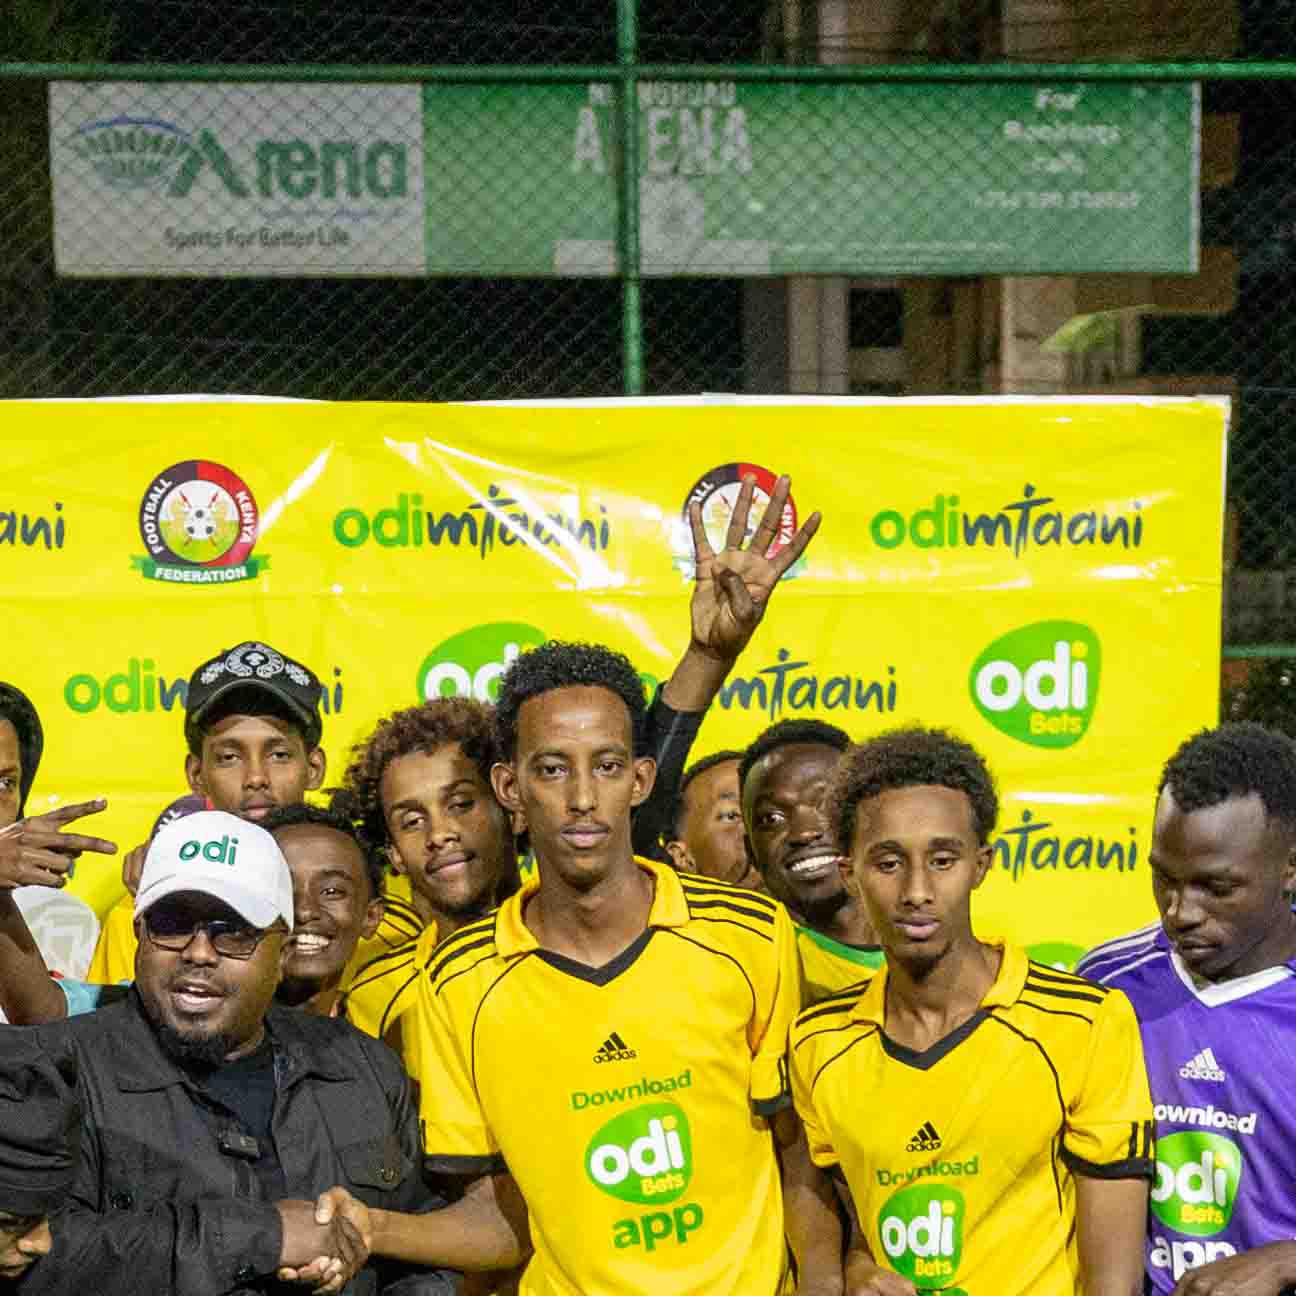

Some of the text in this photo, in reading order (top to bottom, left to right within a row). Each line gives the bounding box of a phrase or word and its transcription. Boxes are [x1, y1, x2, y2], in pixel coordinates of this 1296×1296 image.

[572, 106, 754, 176] AENA
[236, 490, 254, 544] KENYA
[155, 565, 248, 582] FEDERATION
[975, 640, 1090, 711] odi
[178, 834, 239, 866] odi
[593, 1048, 638, 1065] adidas
[571, 1069, 693, 1111] Download
[1153, 1104, 1257, 1136] ownload
[590, 1115, 685, 1186] odi
[640, 1171, 685, 1197] Bets
[613, 1202, 705, 1252] app
[881, 1199, 956, 1258] odi
[1180, 1203, 1225, 1226] Bets
